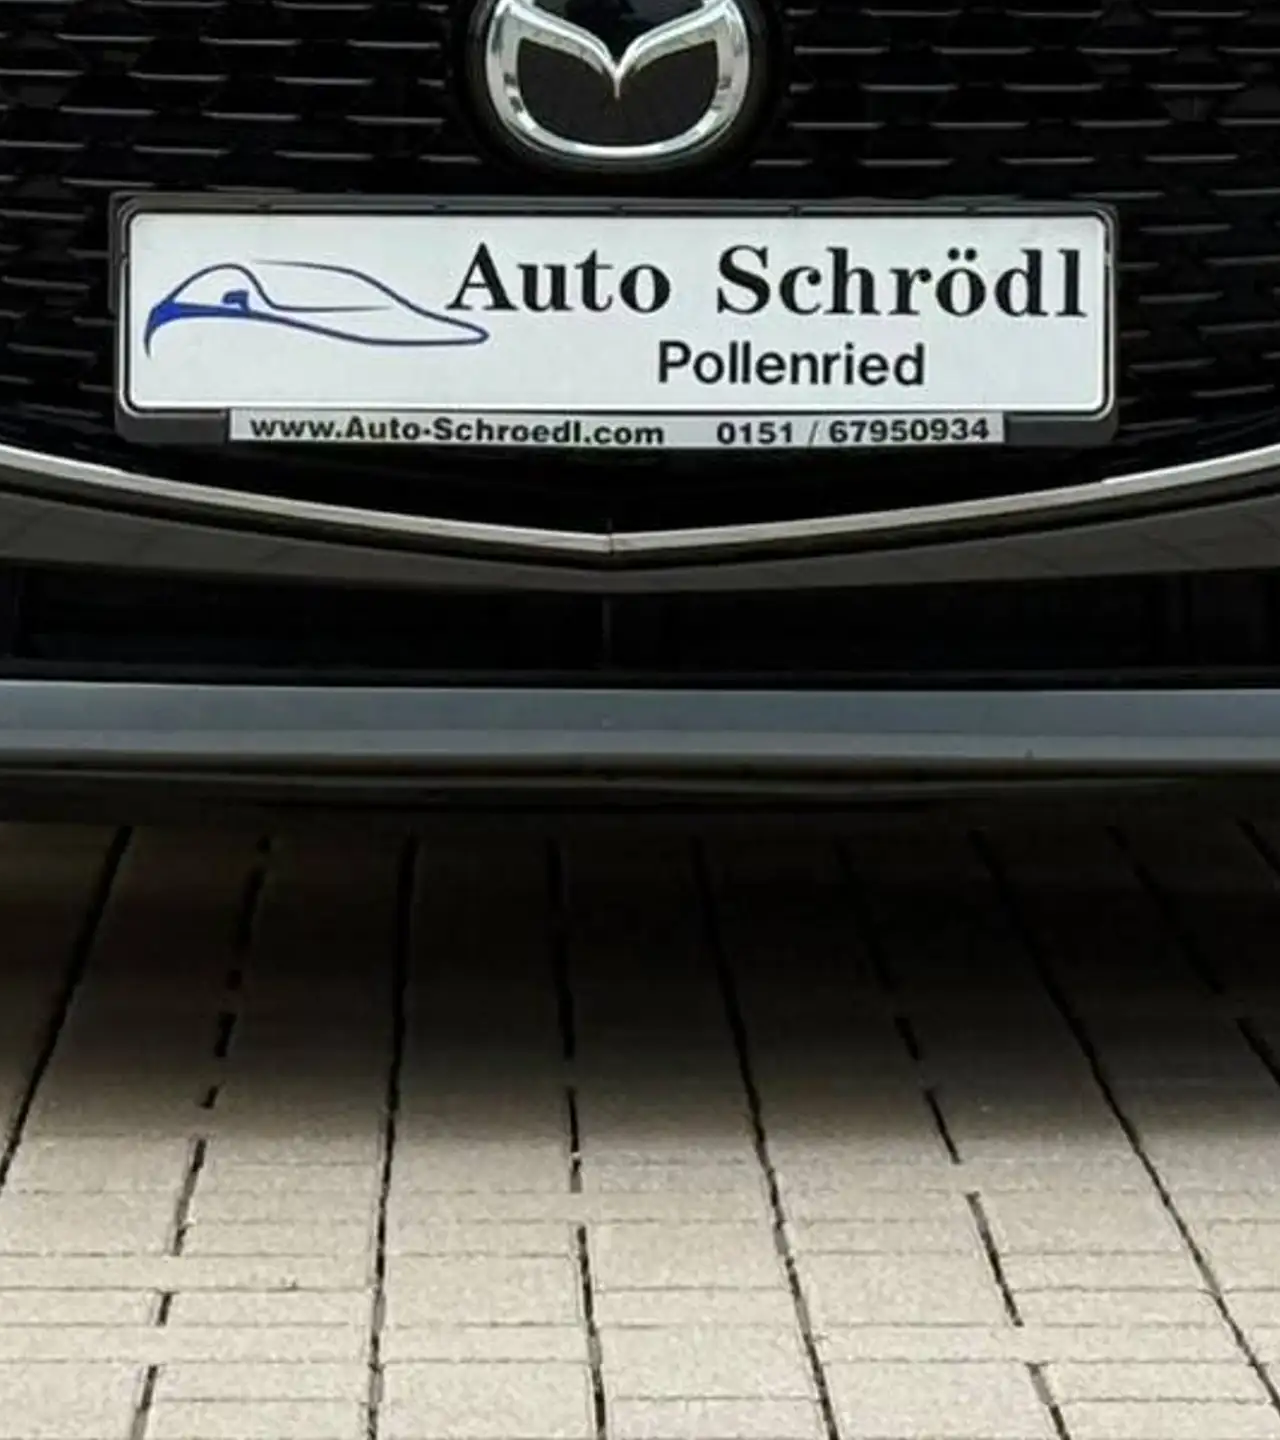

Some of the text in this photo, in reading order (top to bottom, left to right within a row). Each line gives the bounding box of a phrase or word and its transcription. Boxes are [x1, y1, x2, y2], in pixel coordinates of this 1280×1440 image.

[446, 241, 1089, 319] Auto Schrödl
[657, 338, 926, 387] Pollenried
[249, 415, 665, 446] www.Auto-Schroedl.com
[717, 421, 794, 445] 0151
[828, 417, 990, 443] 67950934
